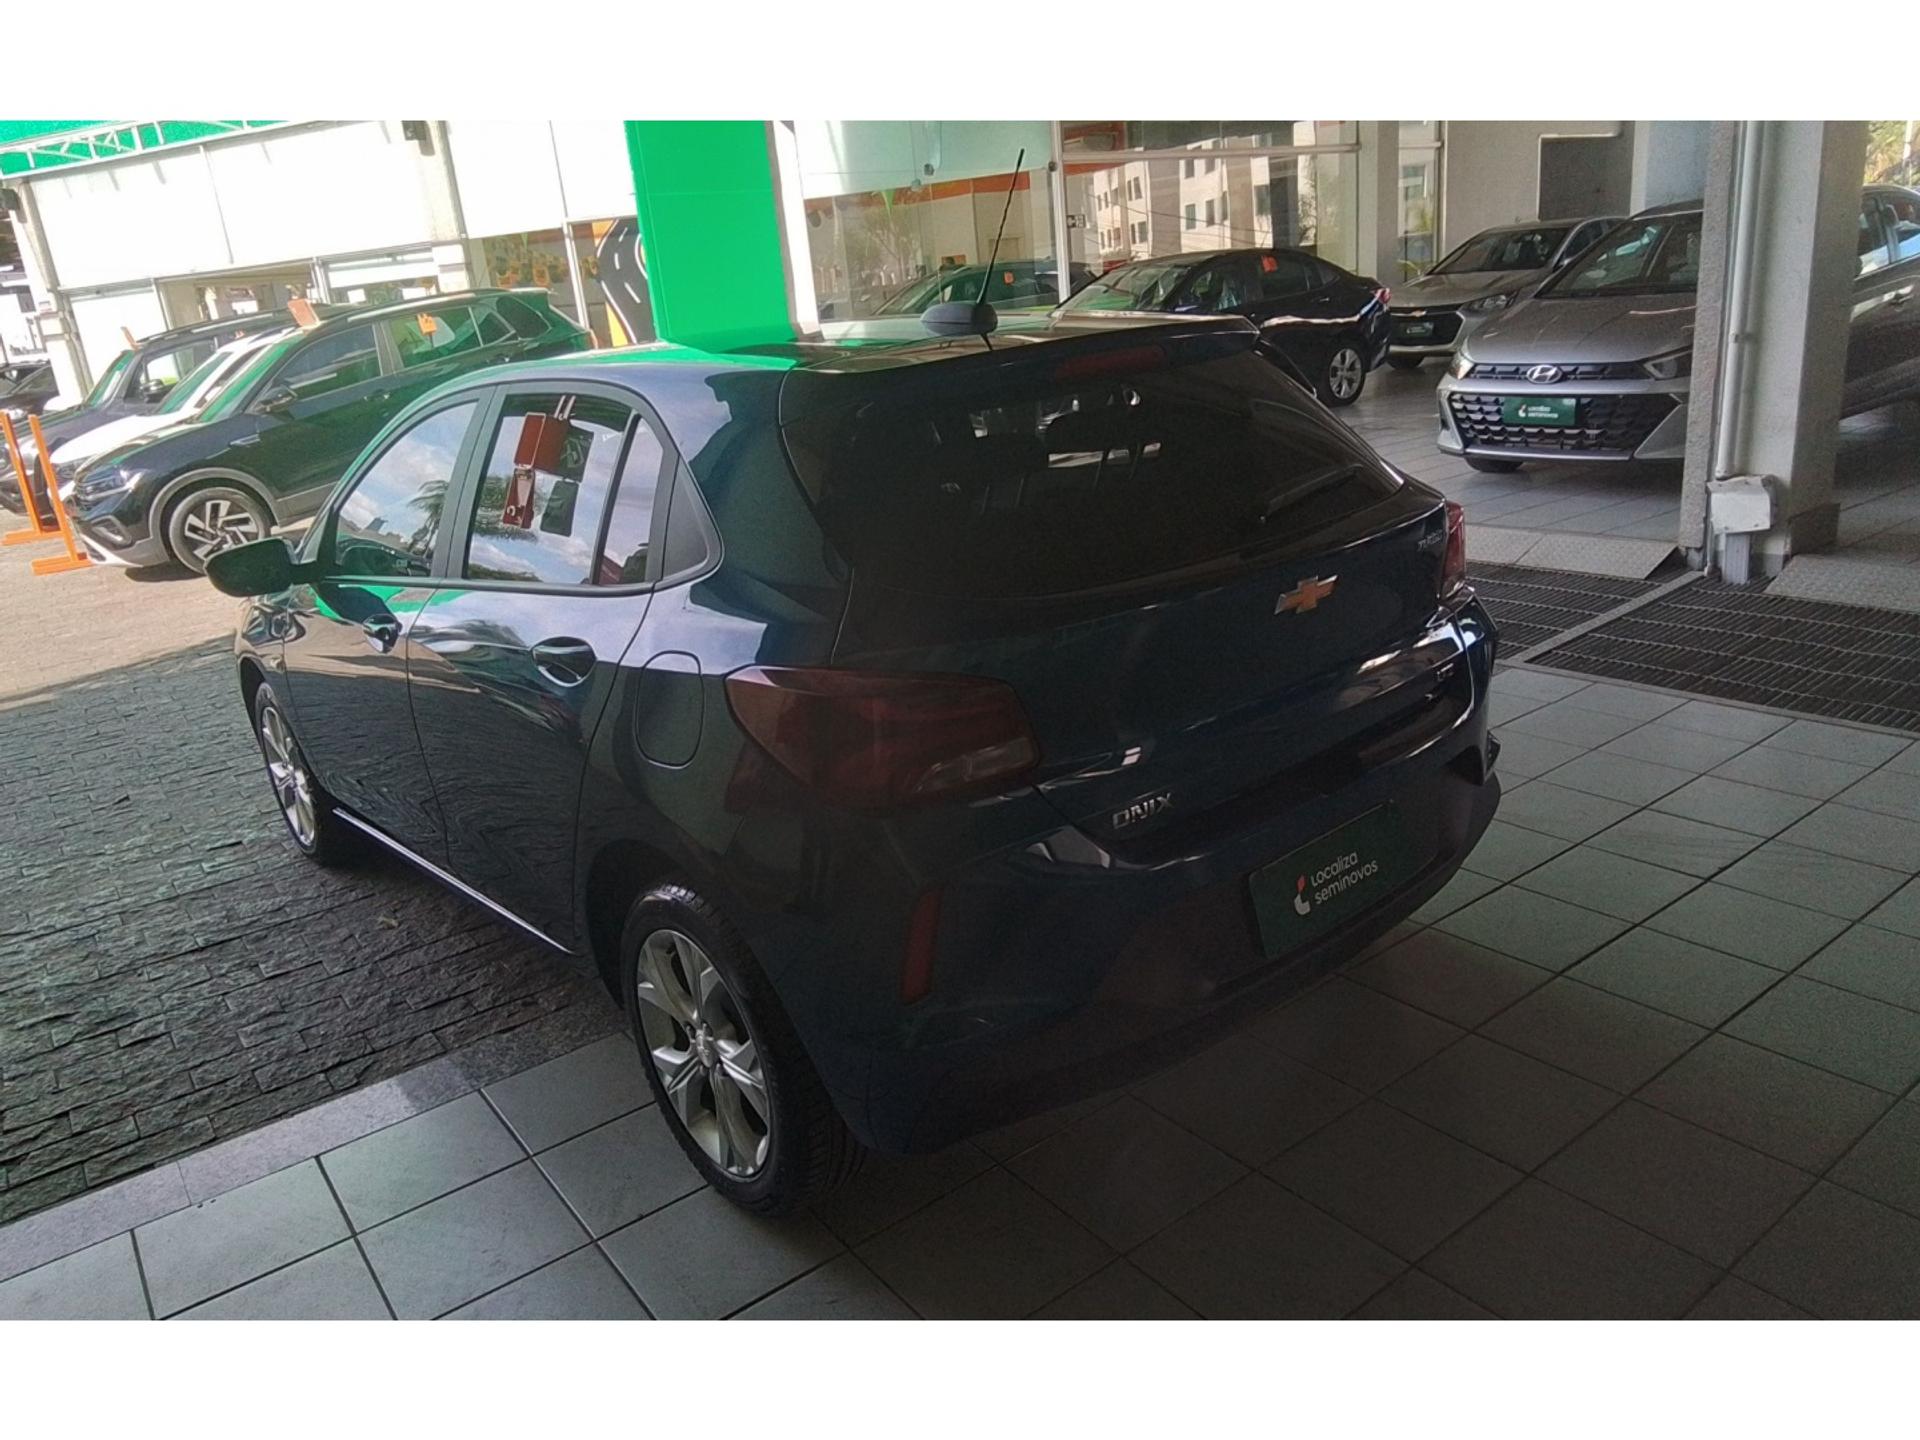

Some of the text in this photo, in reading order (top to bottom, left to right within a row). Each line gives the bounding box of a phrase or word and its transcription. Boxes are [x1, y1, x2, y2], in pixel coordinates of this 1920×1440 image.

[1112, 792, 1171, 830] ONIX
[1310, 851, 1359, 887] Localiza
[1314, 860, 1378, 905] seminovos
